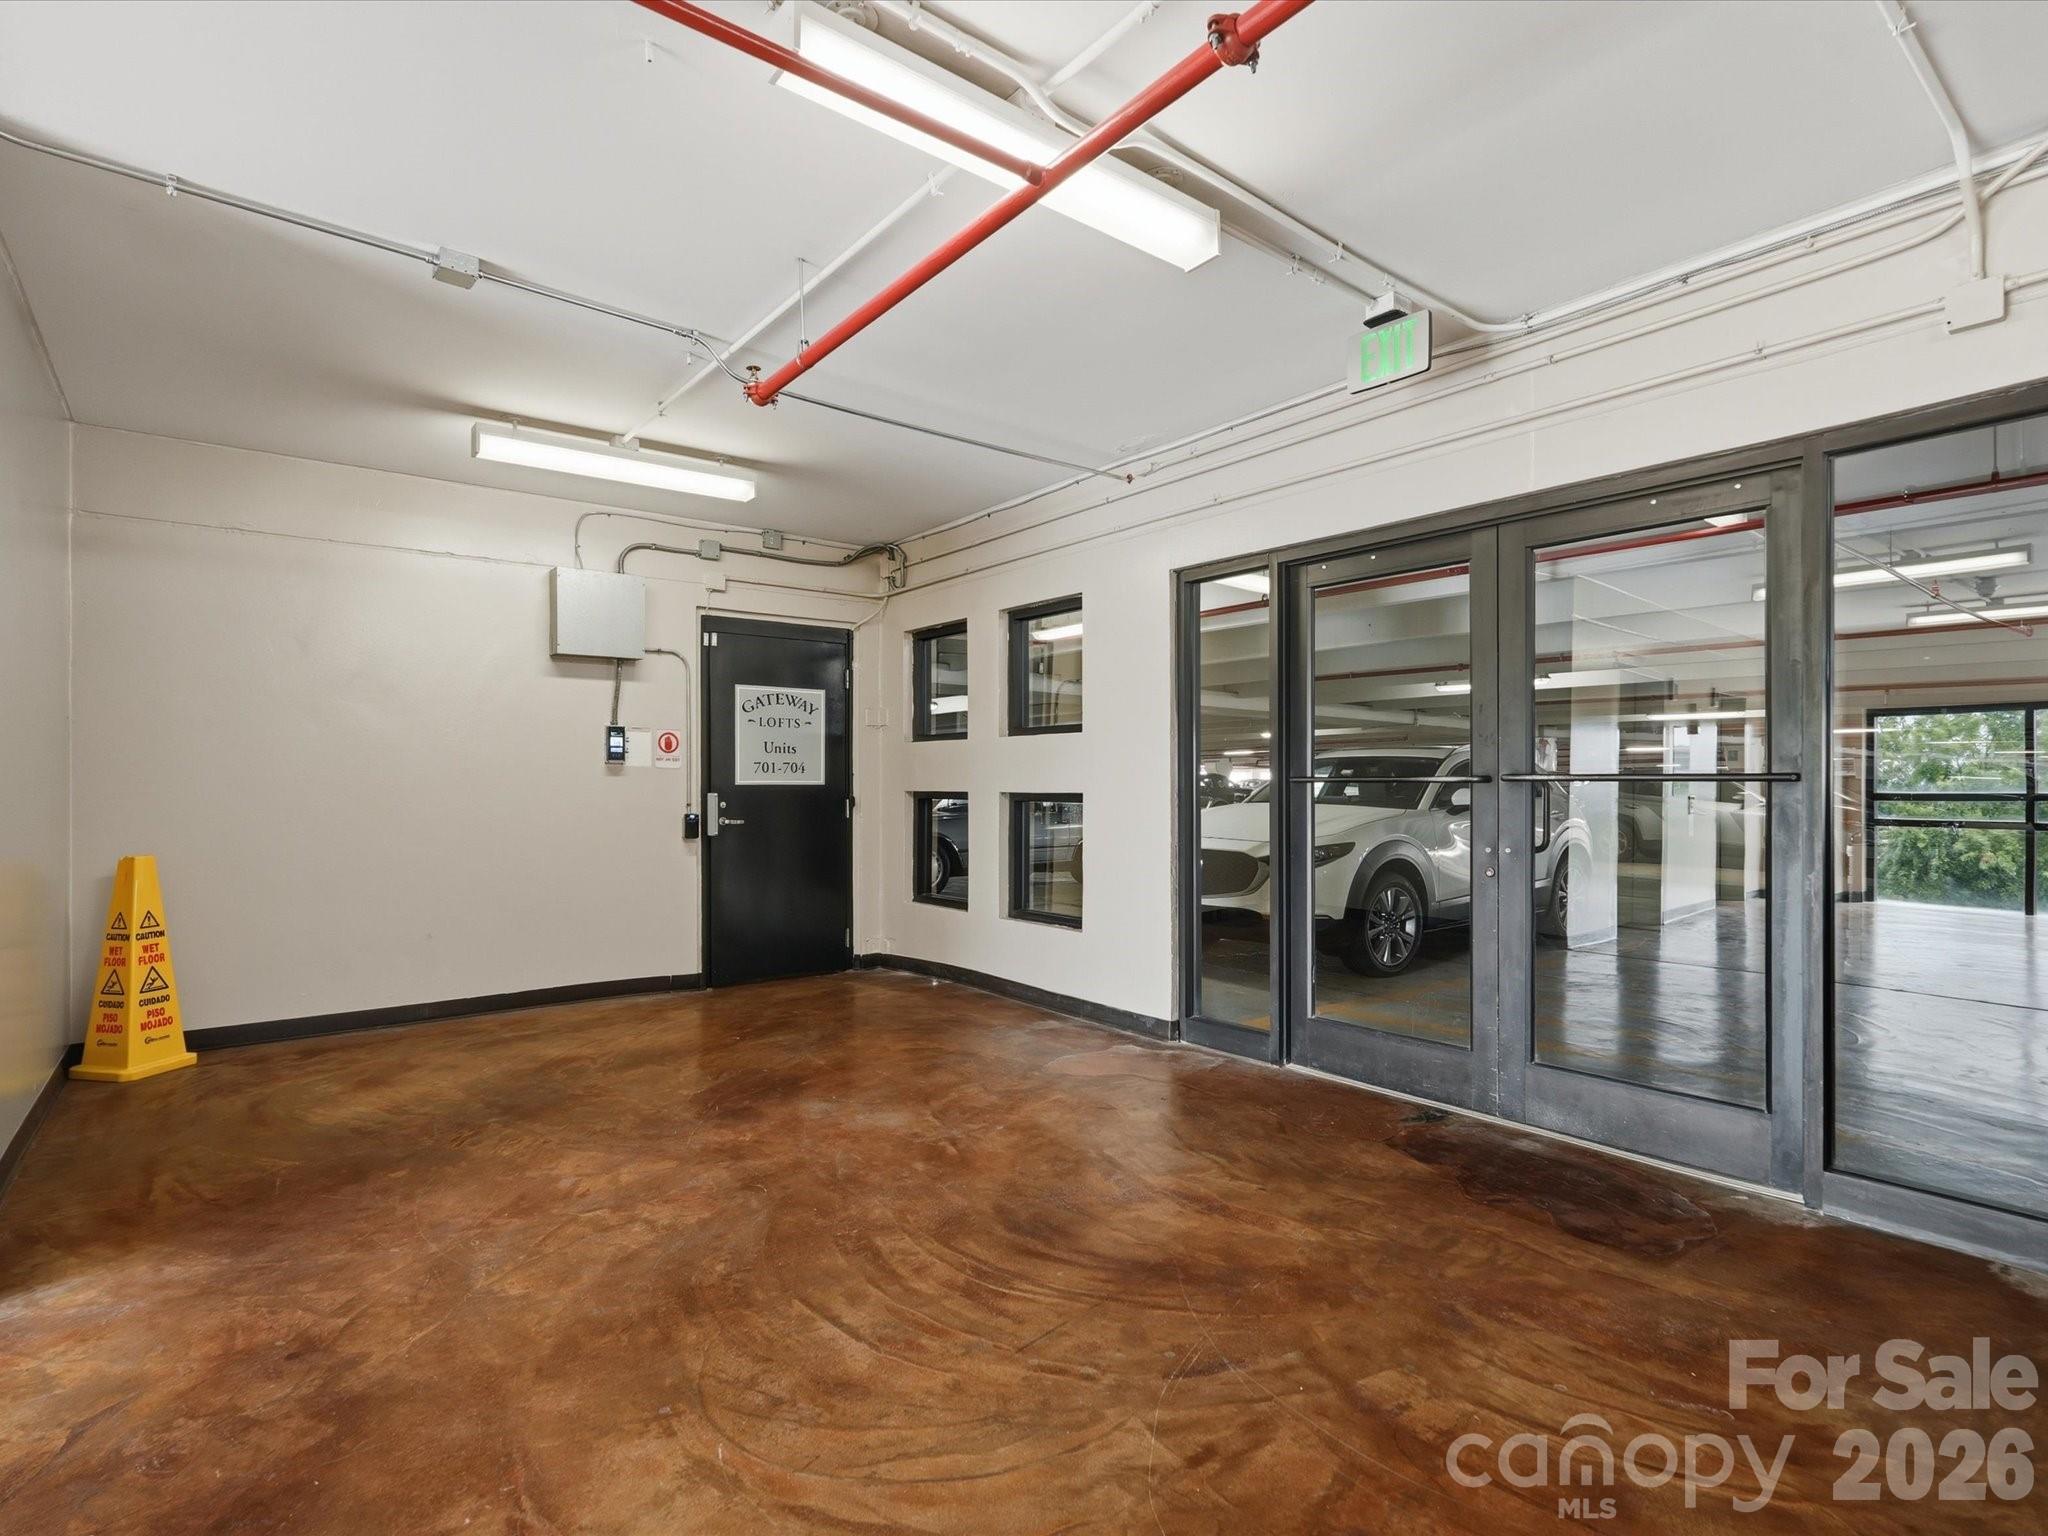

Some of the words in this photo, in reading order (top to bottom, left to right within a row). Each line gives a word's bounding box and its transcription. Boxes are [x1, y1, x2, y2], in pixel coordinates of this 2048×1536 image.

[1360, 317, 1419, 384] EXIT
[741, 692, 819, 715] GATEWAY
[759, 717, 801, 729] LOFTS
[763, 741, 797, 754] Units
[753, 761, 806, 774] 701-704
[106, 933, 131, 942] CAUTION
[135, 930, 165, 941] CAUTION
[109, 946, 123, 956] WET
[142, 943, 160, 954] WET
[103, 957, 127, 967] FLOOR
[138, 953, 166, 966] FLOOR
[98, 1000, 125, 1009] CUIDADO
[138, 994, 171, 1007] CUIDADO
[102, 1013, 118, 1023] PISO
[146, 1007, 165, 1019] PISO
[95, 1024, 123, 1034] MOJADO
[140, 1016, 173, 1032] MOJADO
